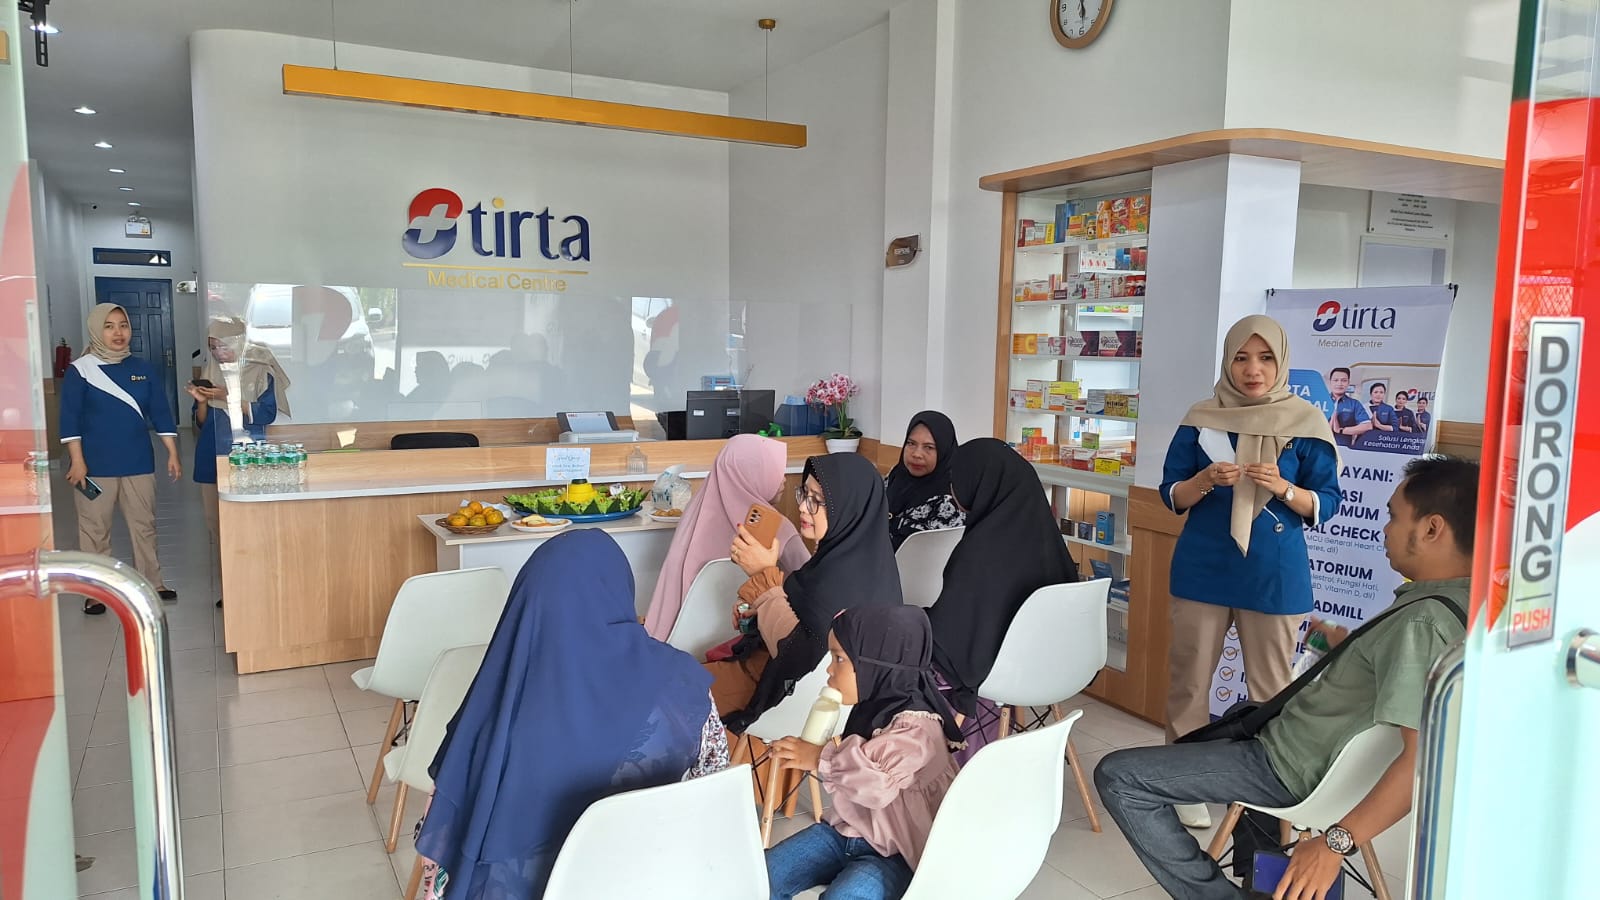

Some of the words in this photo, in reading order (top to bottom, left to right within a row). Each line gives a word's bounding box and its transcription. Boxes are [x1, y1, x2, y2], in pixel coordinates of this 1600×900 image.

[467, 197, 591, 262] tirta
[427, 270, 504, 289] Medical
[507, 273, 568, 292] Centre
[1342, 303, 1396, 330] tirta
[1318, 339, 1351, 348] Medical
[1352, 339, 1383, 348] Centre
[1363, 440, 1400, 449] Kesehatan
[1402, 443, 1420, 451] Anda
[1519, 336, 1570, 584] DORONG
[1335, 504, 1380, 521] MUM
[1330, 524, 1381, 543] CHECK
[1324, 537, 1353, 548] General
[1354, 541, 1375, 551] Heart
[1325, 585, 1353, 596] Vitamin
[1337, 577, 1361, 589] Fungsi
[1512, 607, 1551, 634] PUSH
